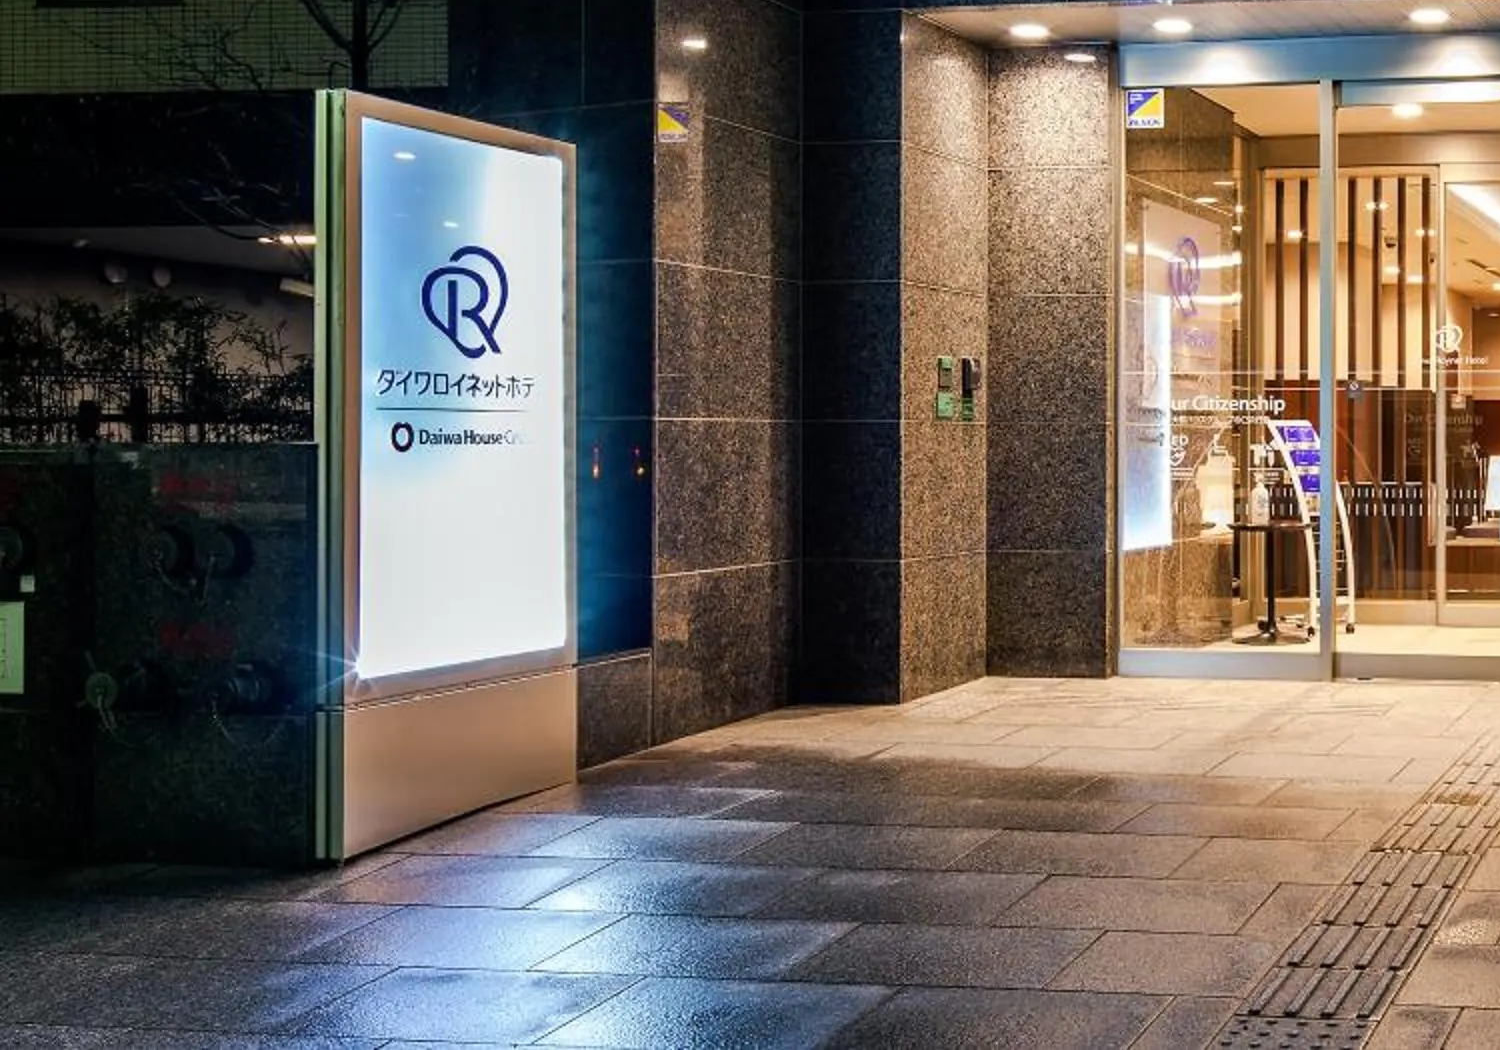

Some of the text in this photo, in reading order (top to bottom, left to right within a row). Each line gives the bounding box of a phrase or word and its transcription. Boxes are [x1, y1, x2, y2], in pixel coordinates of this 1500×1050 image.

[1193, 395, 1285, 414] Citizenship
[419, 428, 462, 445] Daiwa
[464, 429, 503, 445] House
